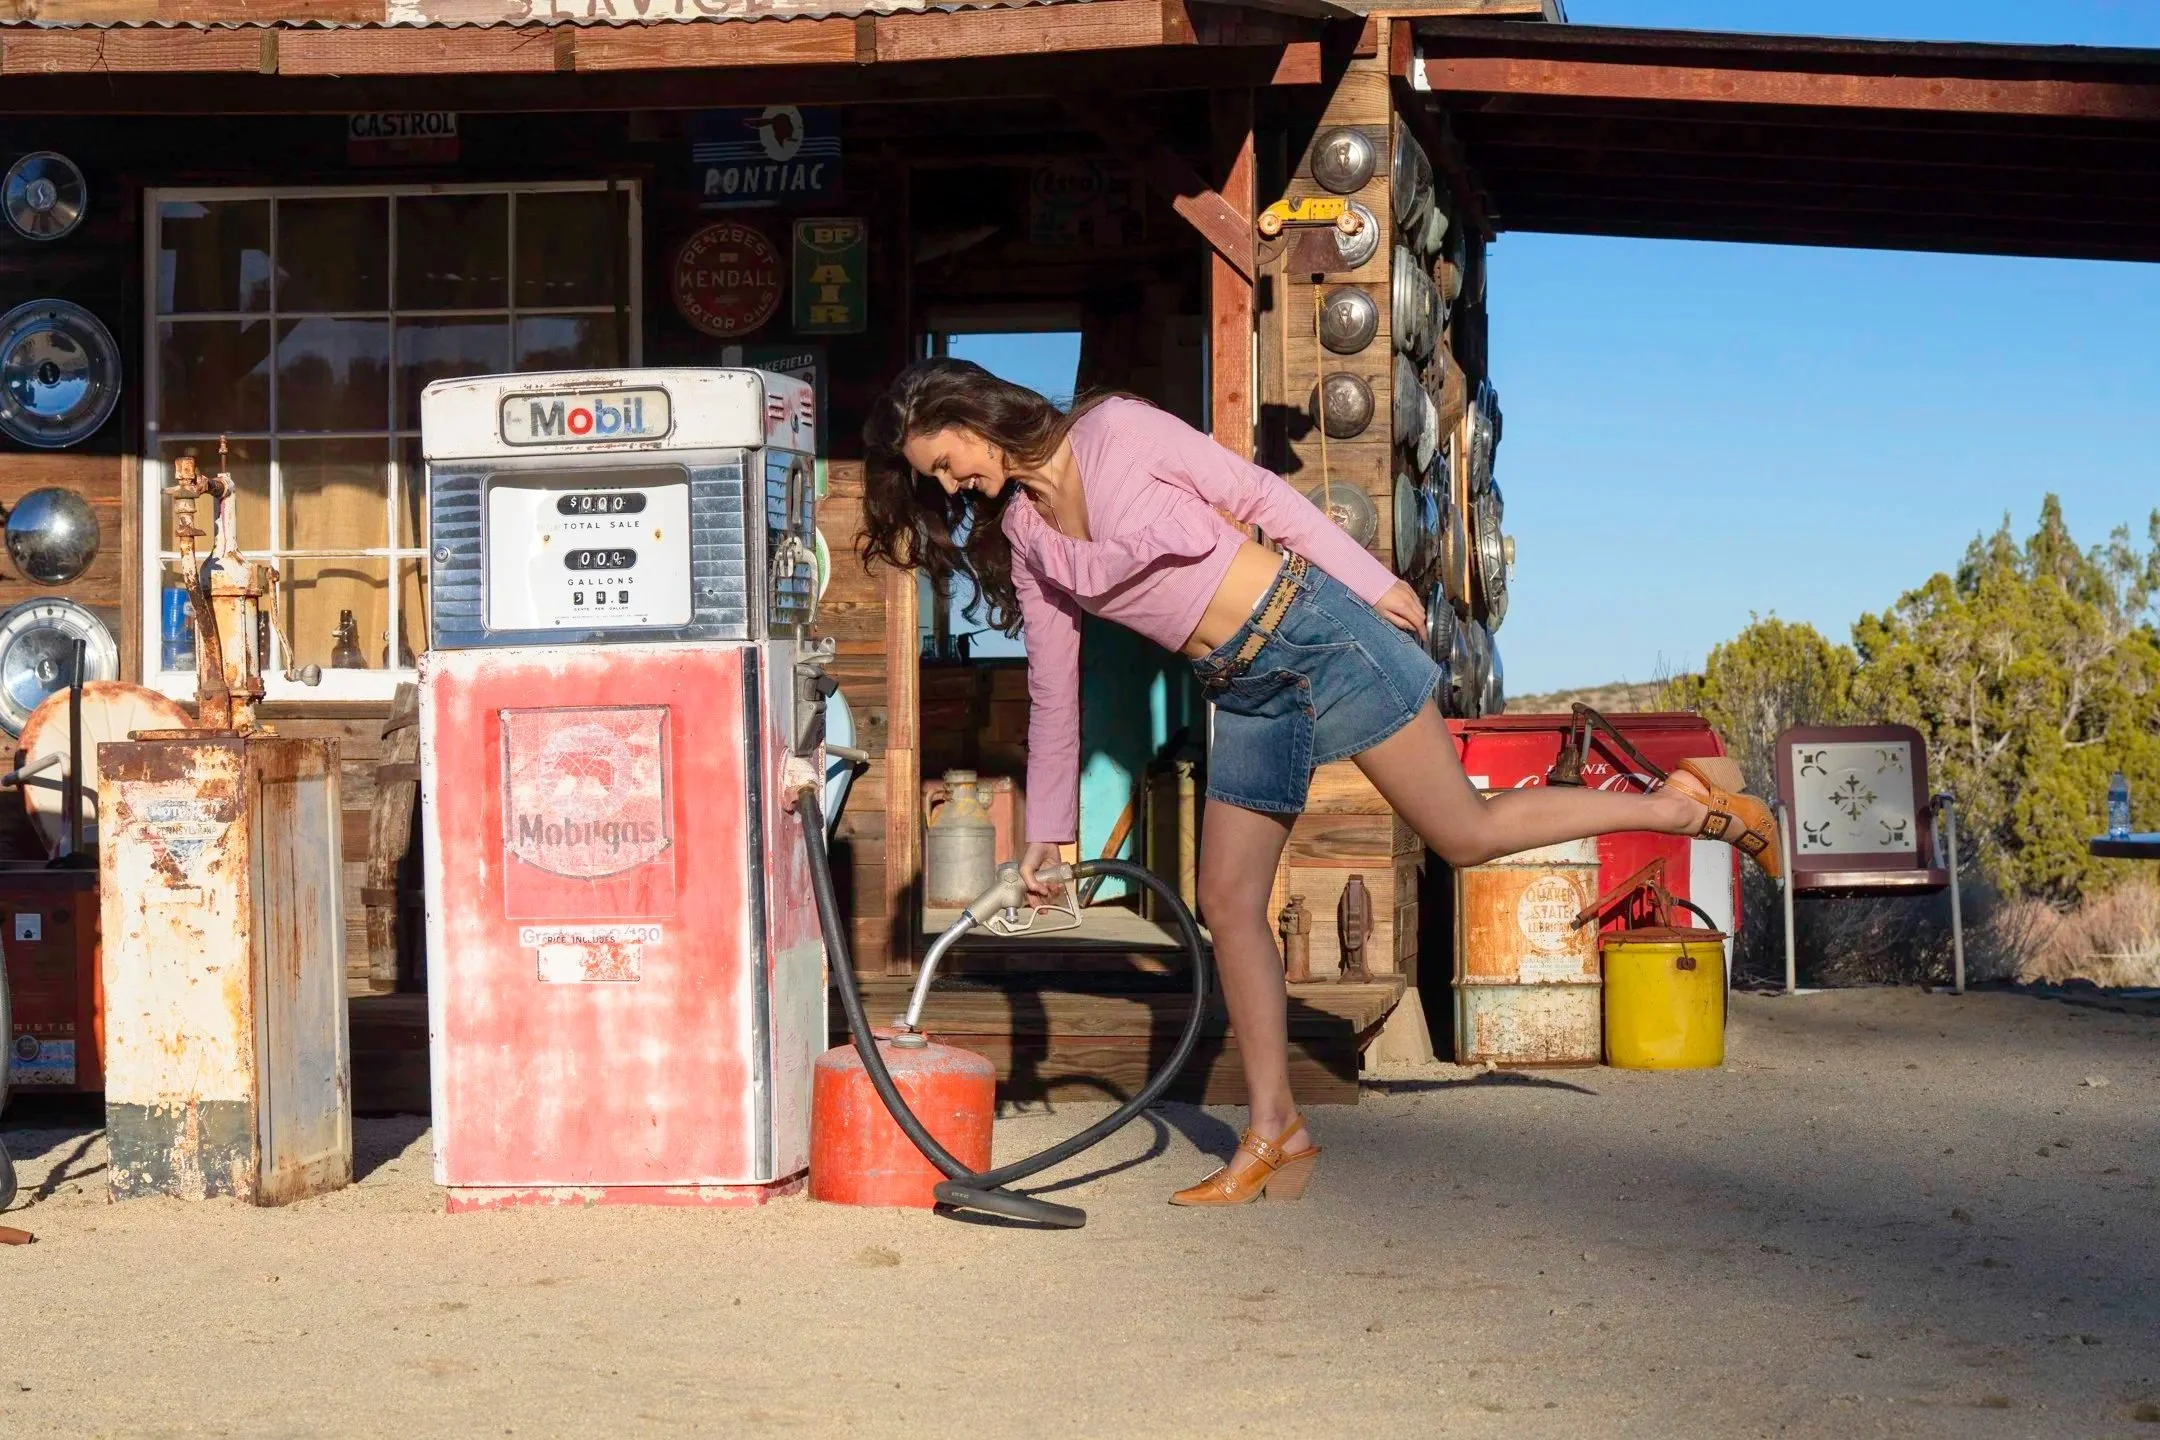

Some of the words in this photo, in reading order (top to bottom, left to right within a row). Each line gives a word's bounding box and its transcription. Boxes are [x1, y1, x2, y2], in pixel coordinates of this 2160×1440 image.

[351, 113, 456, 137] CASTROL
[704, 162, 825, 195] PONTIAC
[812, 227, 856, 244] BP
[682, 227, 776, 265] PENZBEST
[680, 269, 777, 289] KENDALL
[682, 292, 737, 329] MOTOR
[743, 290, 774, 324] OILS
[755, 354, 813, 371] AKEFIELD
[530, 397, 643, 446] Mobil
[563, 522, 601, 530] TOTAL
[609, 520, 640, 529] SALE
[567, 577, 634, 586] GALLONS
[1526, 886, 1575, 903] QUAKER
[1532, 904, 1569, 919] STATE
